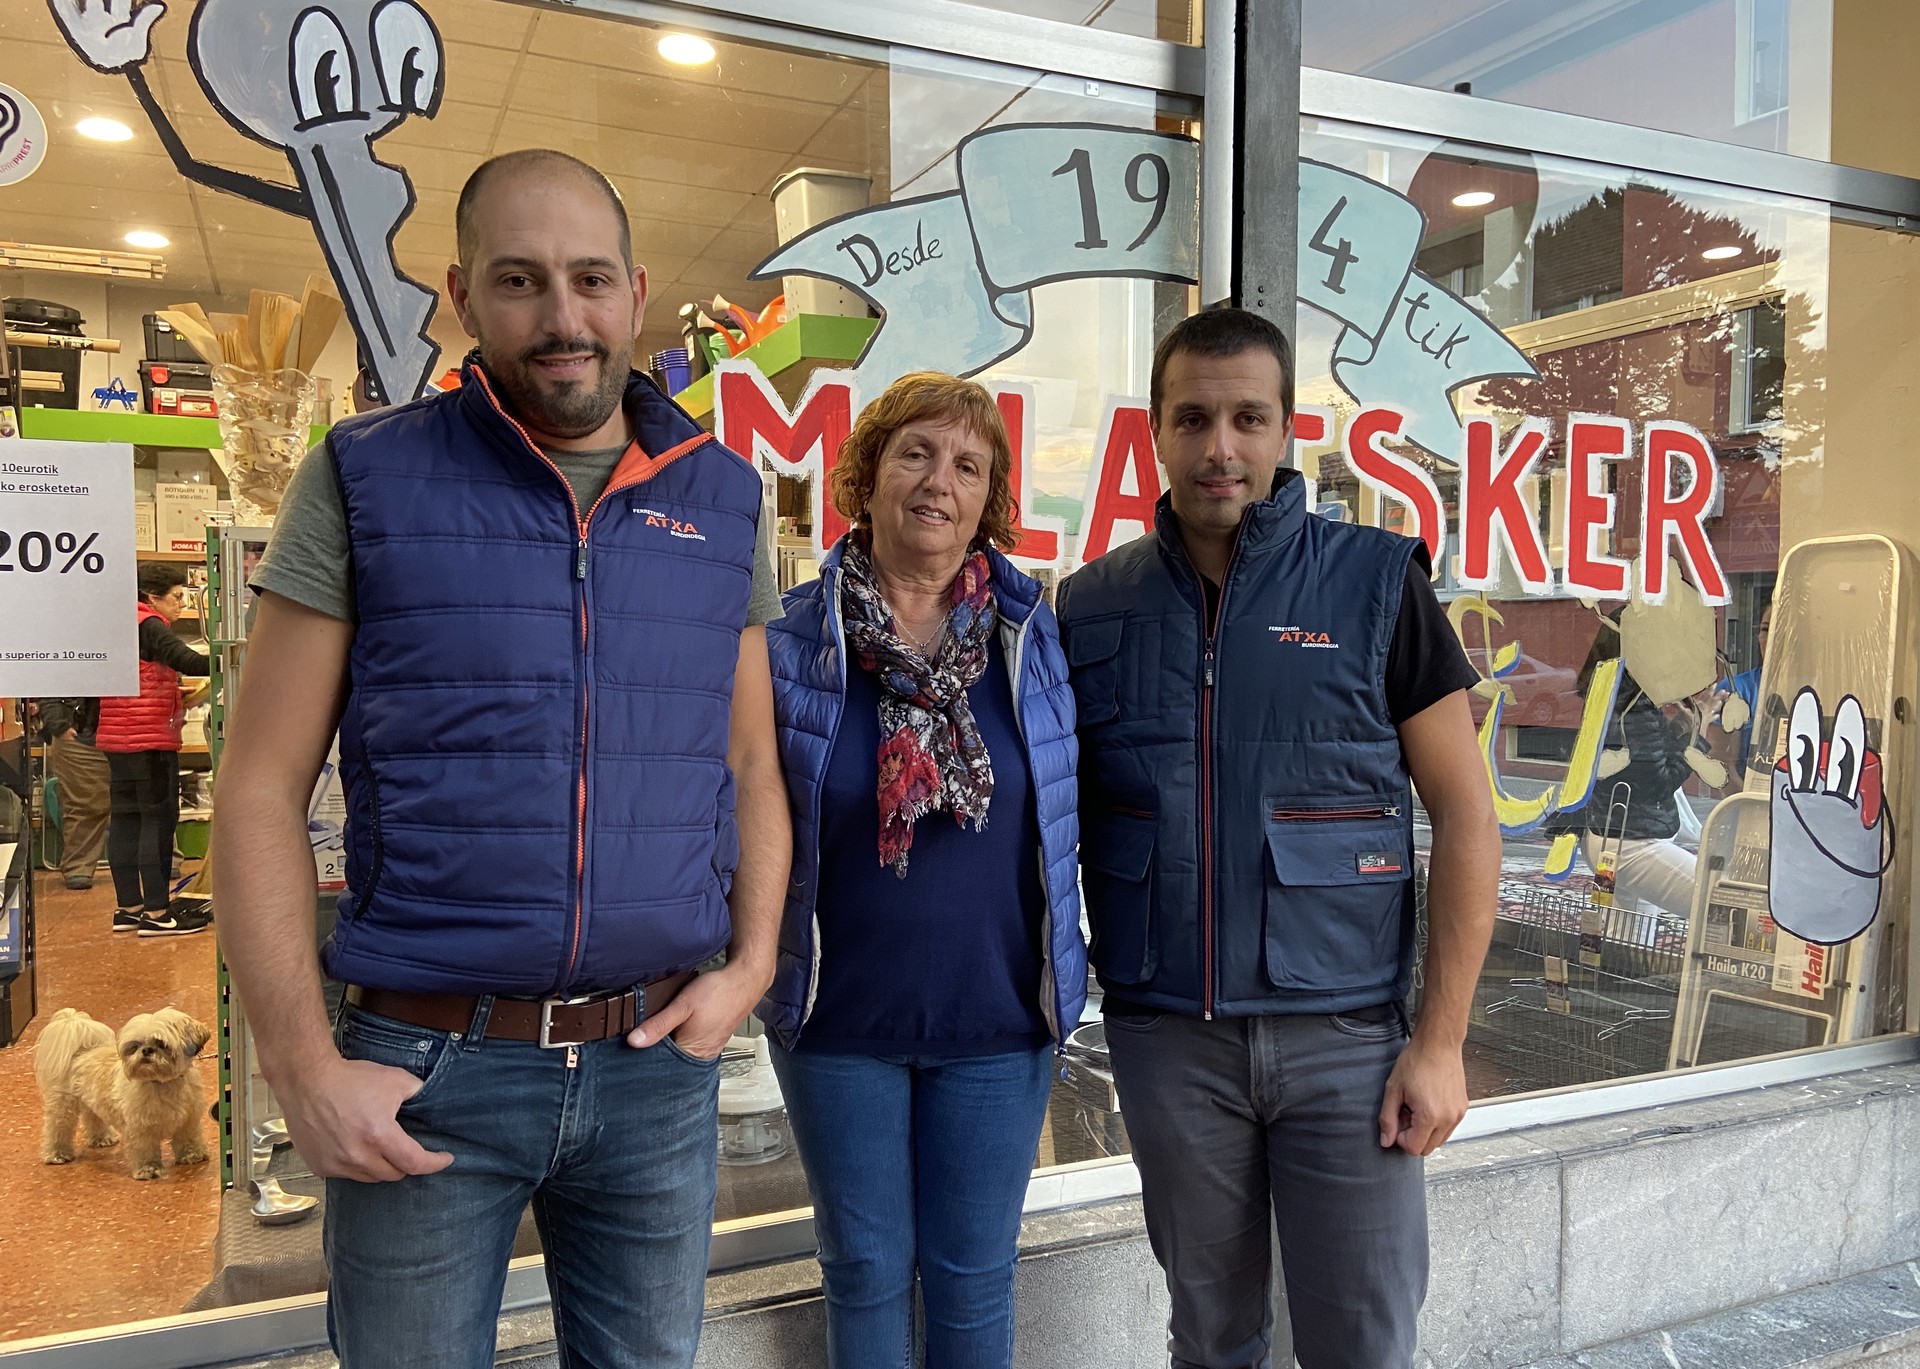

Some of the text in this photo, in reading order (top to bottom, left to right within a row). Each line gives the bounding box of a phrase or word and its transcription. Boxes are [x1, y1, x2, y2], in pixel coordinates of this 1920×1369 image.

[836, 219, 943, 288] Desde
[1404, 291, 1470, 370] tik
[1, 463, 59, 474] 10eurotik
[0, 481, 89, 494] ko erosketetan
[716, 366, 1731, 602] MLA SKER
[645, 515, 698, 534] ATXA
[1279, 631, 1331, 643] ATXA
[5, 650, 50, 660] superior
[62, 651, 75, 659] 10
[78, 652, 108, 660] euros
[325, 863, 334, 874] 2
[1707, 955, 1767, 981] Hailo K20
[1801, 943, 1825, 996] Hail
